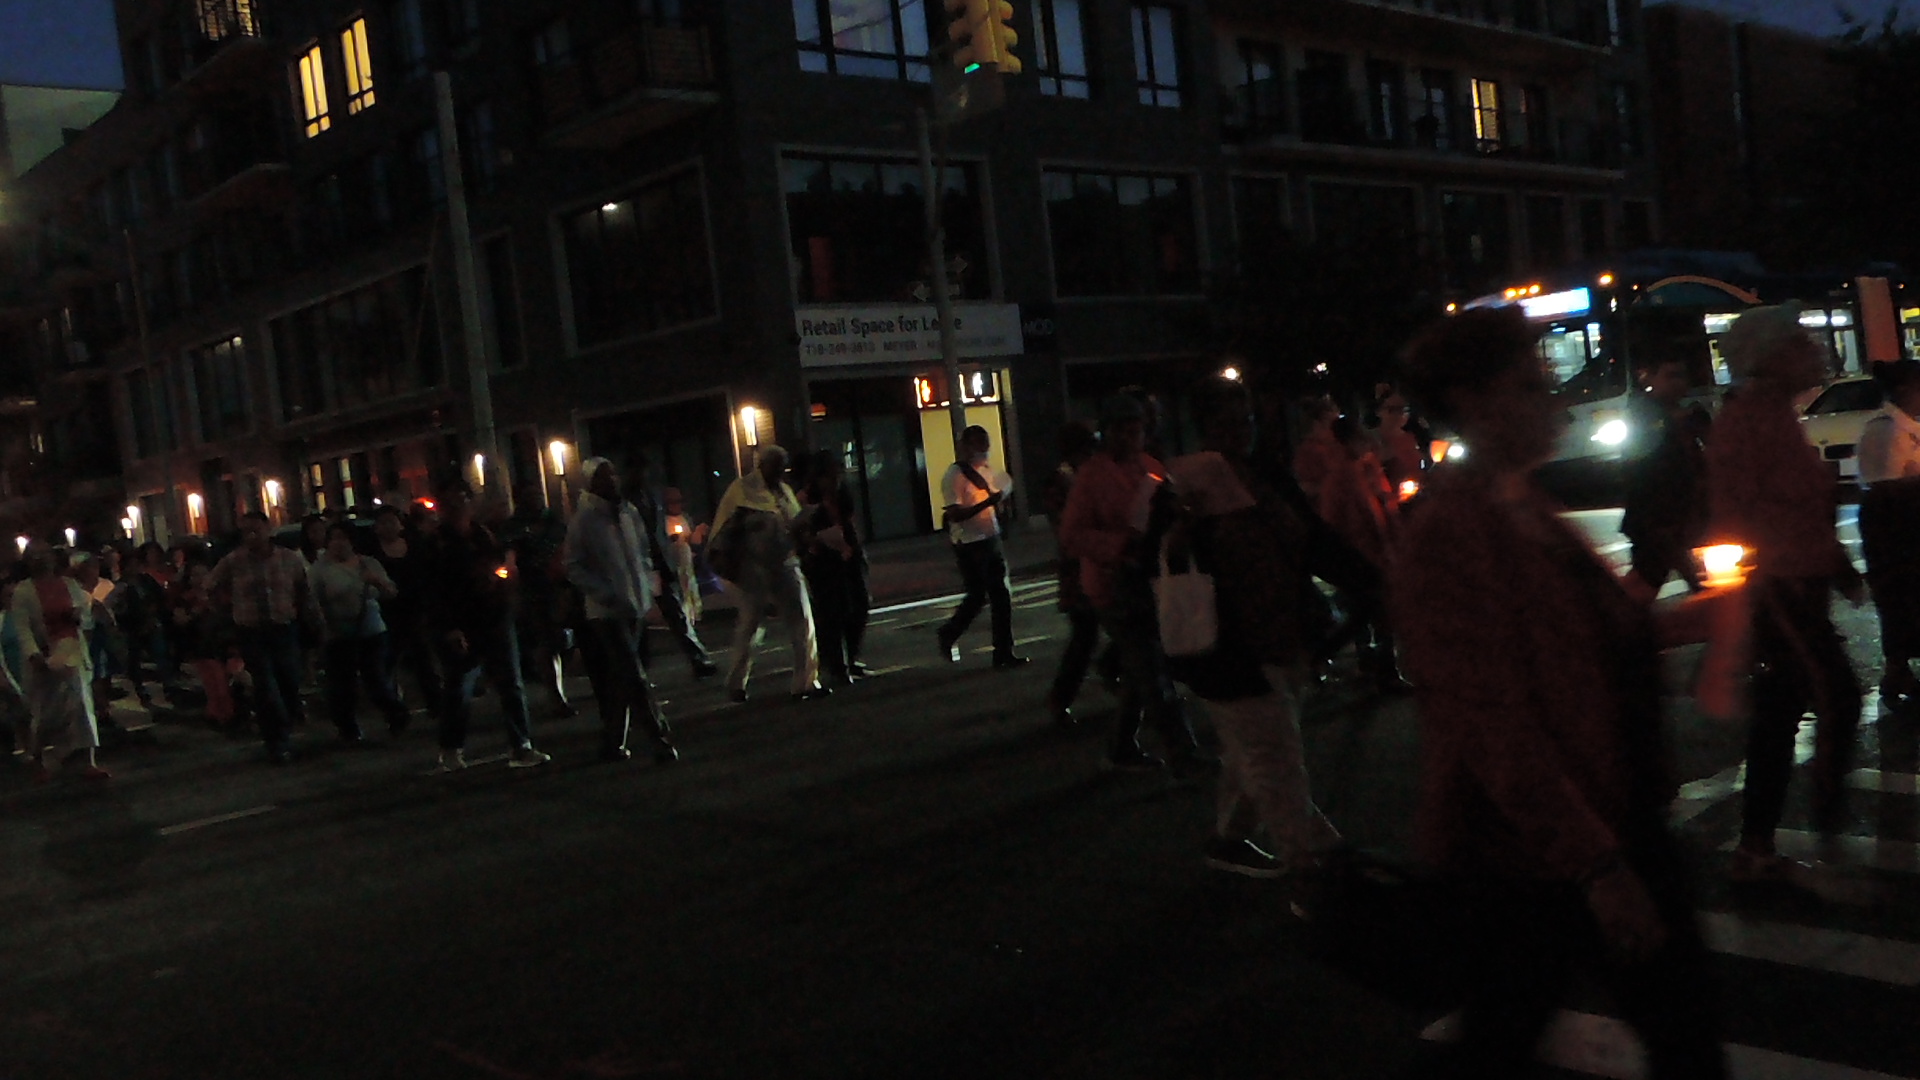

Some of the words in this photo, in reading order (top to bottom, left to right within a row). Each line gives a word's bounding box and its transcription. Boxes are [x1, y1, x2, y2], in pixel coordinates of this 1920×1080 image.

[802, 316, 846, 337] Retail
[850, 317, 894, 339] Space
[898, 314, 918, 332] for
[922, 316, 962, 332] Lee
